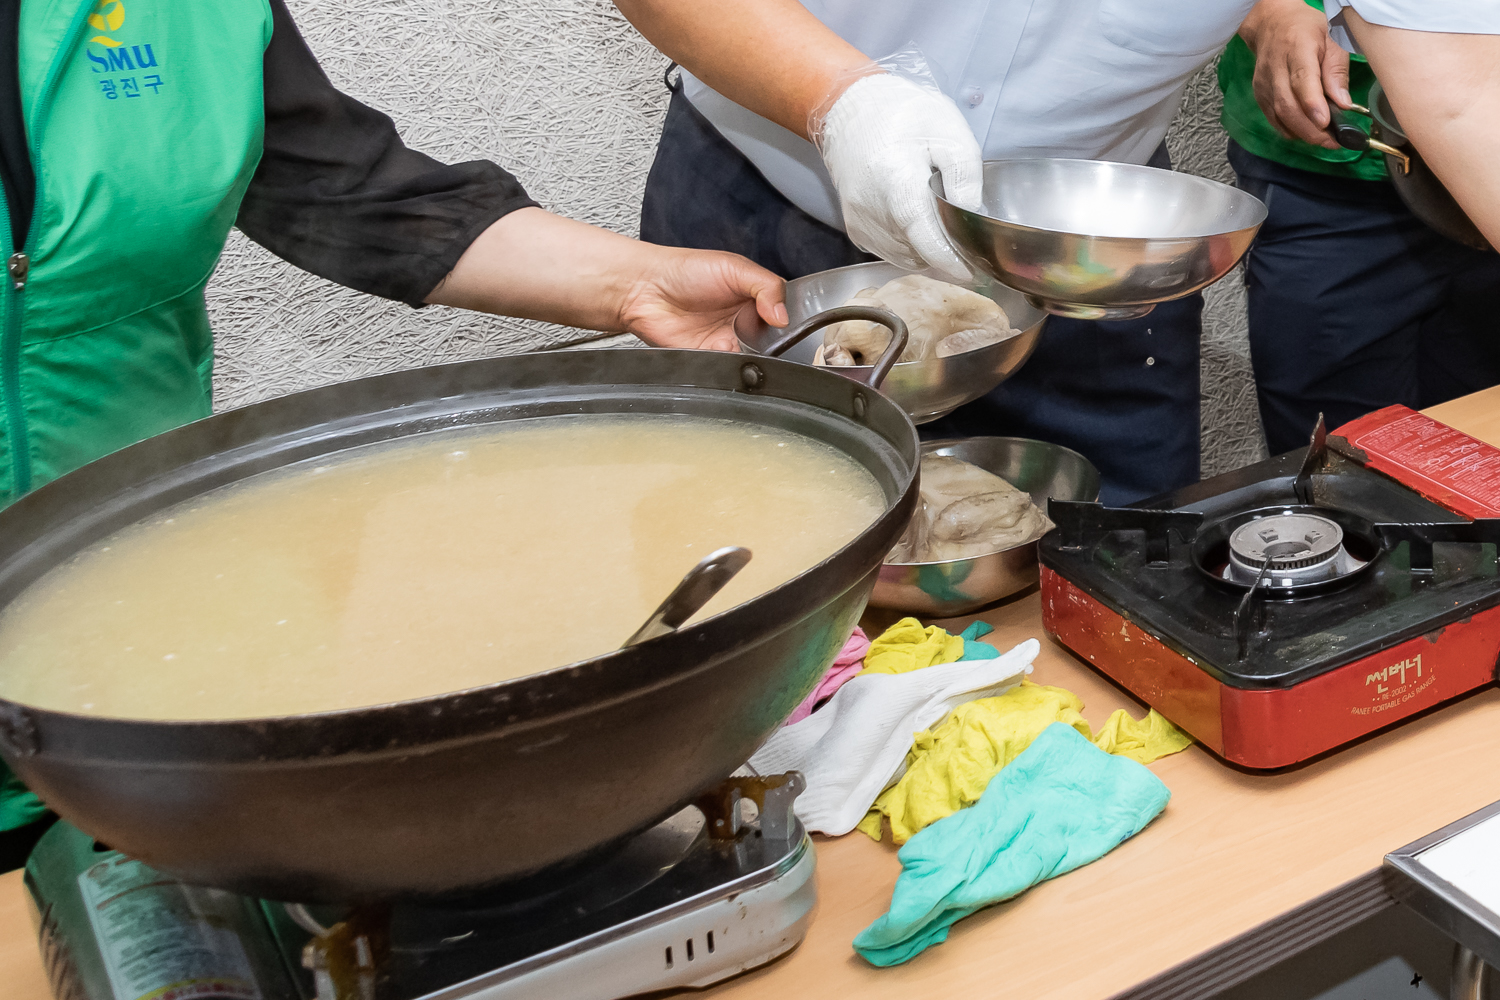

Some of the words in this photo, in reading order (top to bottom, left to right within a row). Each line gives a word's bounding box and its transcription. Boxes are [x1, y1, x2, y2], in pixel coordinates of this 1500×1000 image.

[86, 44, 159, 73] SMU
[99, 75, 164, 100] 광진구
[1365, 653, 1422, 694] 썬버너
[1372, 697, 1401, 713] PORTABLE
[1401, 690, 1416, 703] GAS
[1415, 674, 1437, 695] RANGE
